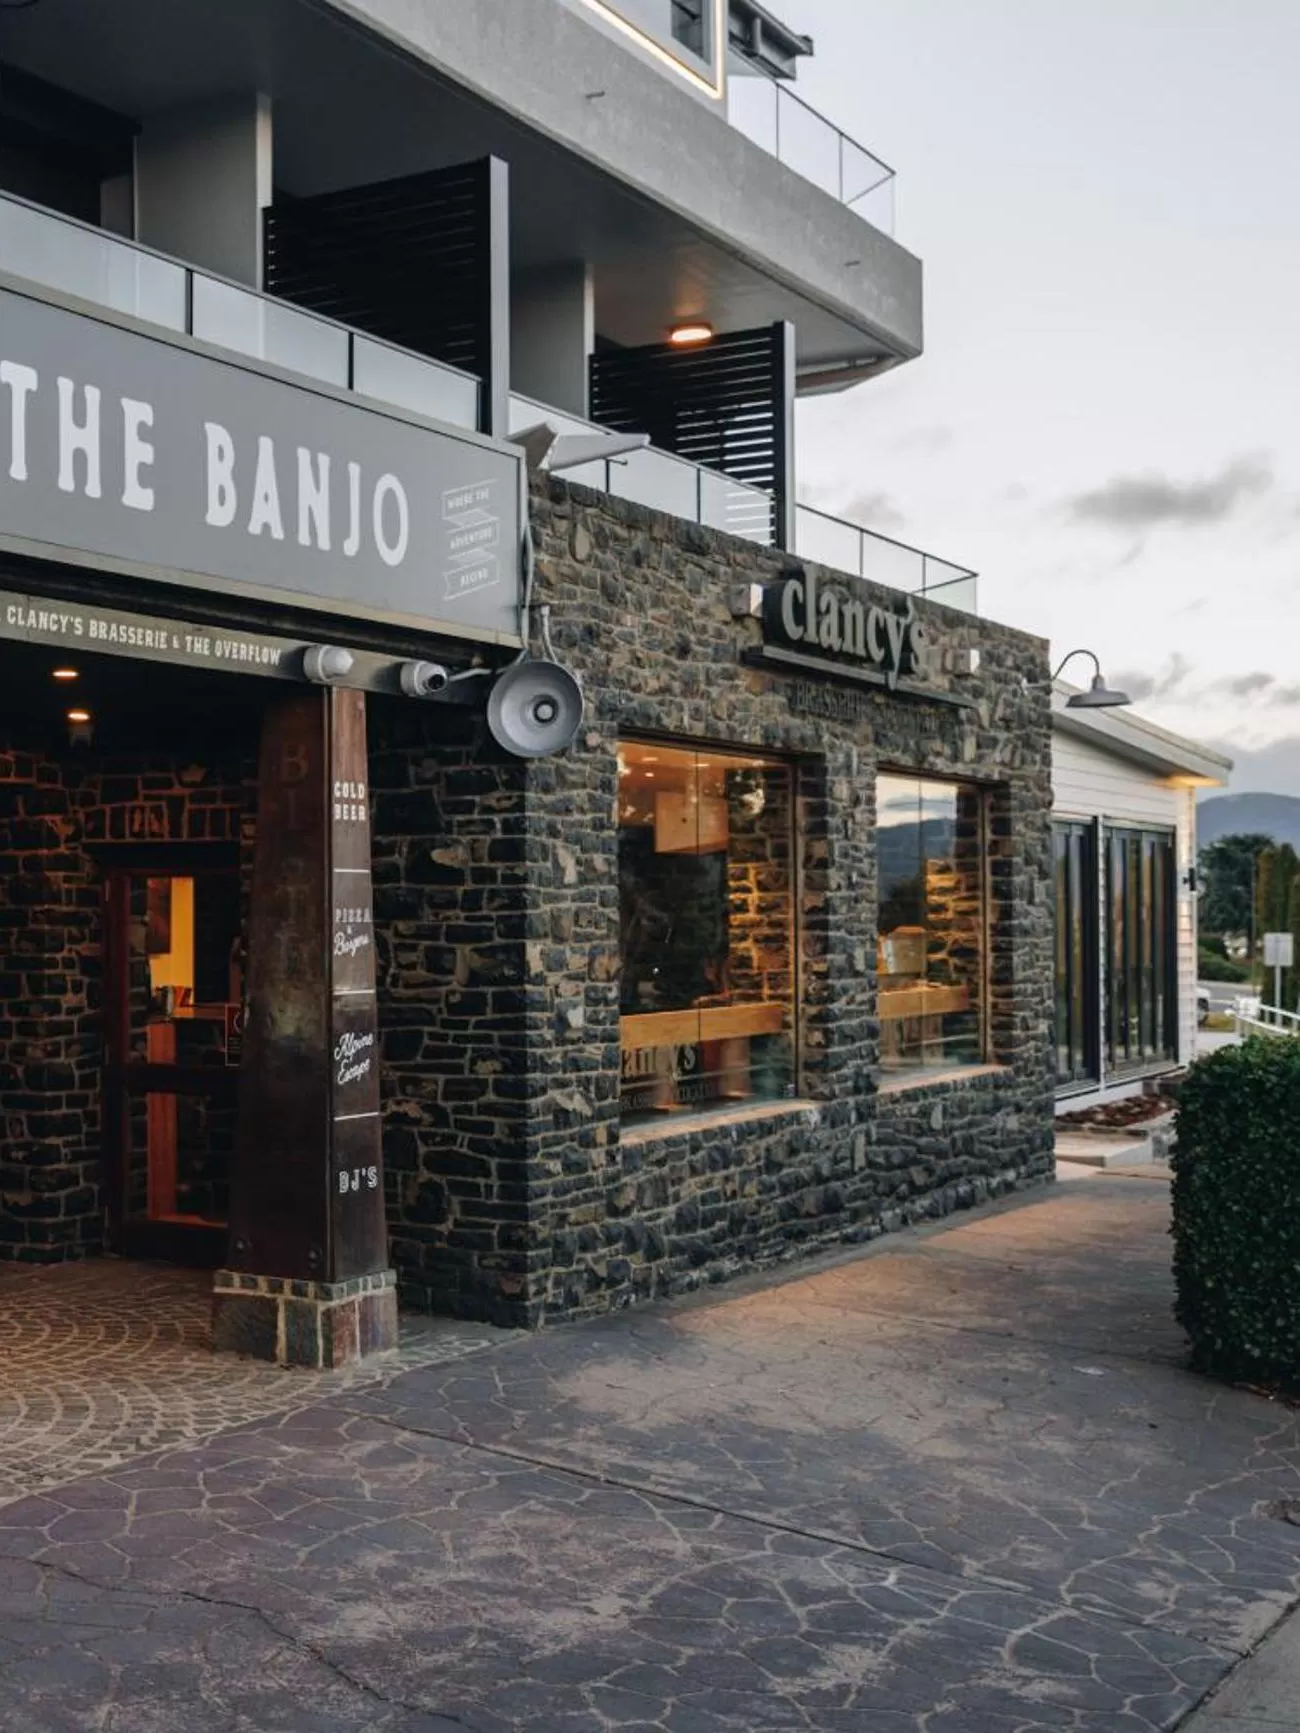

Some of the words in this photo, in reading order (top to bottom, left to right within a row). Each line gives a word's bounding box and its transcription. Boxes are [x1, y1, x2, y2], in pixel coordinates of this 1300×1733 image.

[0, 360, 156, 511] THE
[203, 421, 410, 567] BANJO
[6, 607, 84, 636] CLANCY'S
[89, 619, 168, 650] BRASSERIE
[172, 634, 181, 650] &
[185, 636, 211, 657] THE
[214, 640, 282, 667] OVERFLOW
[781, 562, 929, 691] clancy's
[333, 781, 365, 799] COLD
[334, 803, 366, 821] BEER
[339, 1165, 378, 1193] DJ'S
